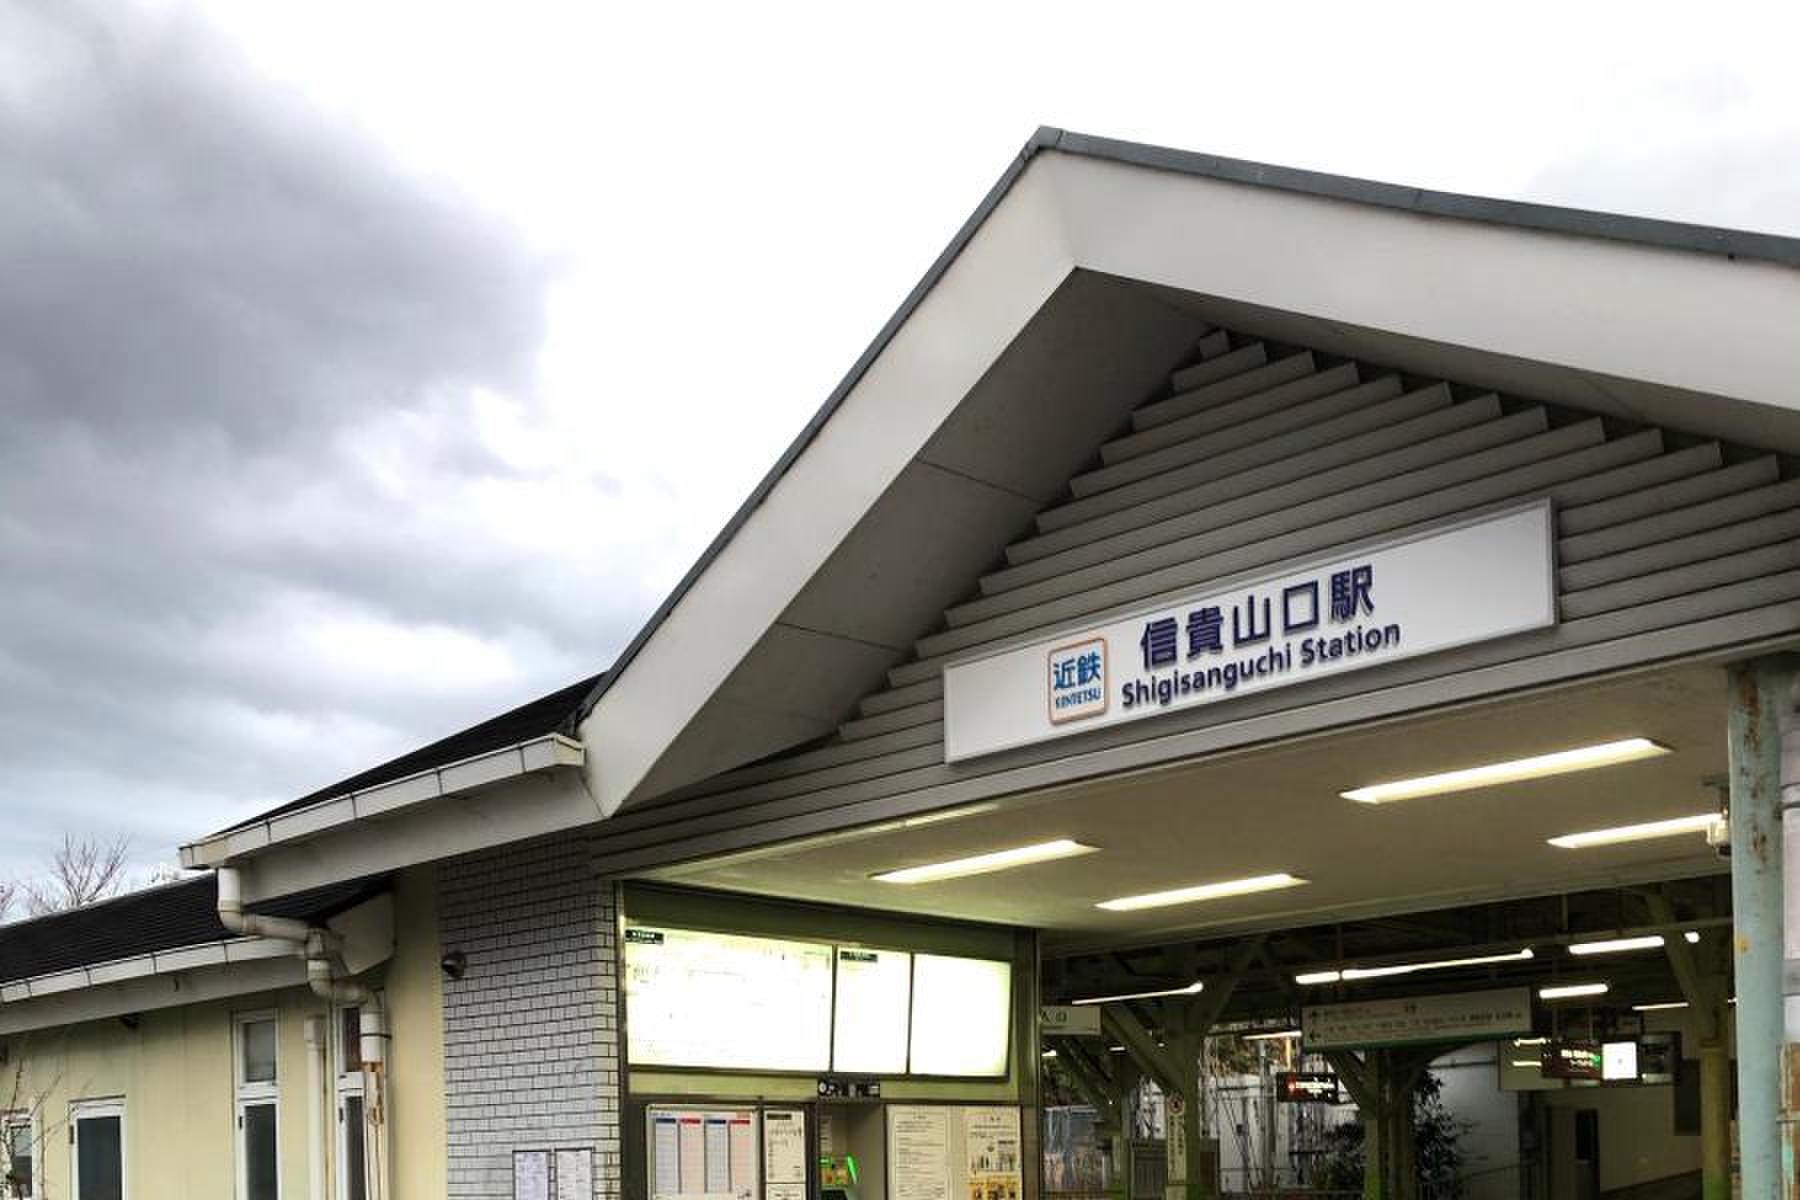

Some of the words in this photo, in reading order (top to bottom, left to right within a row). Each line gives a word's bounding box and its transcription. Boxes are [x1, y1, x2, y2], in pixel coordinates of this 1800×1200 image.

[1140, 565, 1374, 669] 信貴山口駅
[1053, 652, 1102, 690] 近鉄
[1122, 642, 1292, 707] Shigisanguchi
[1301, 624, 1400, 666] Station
